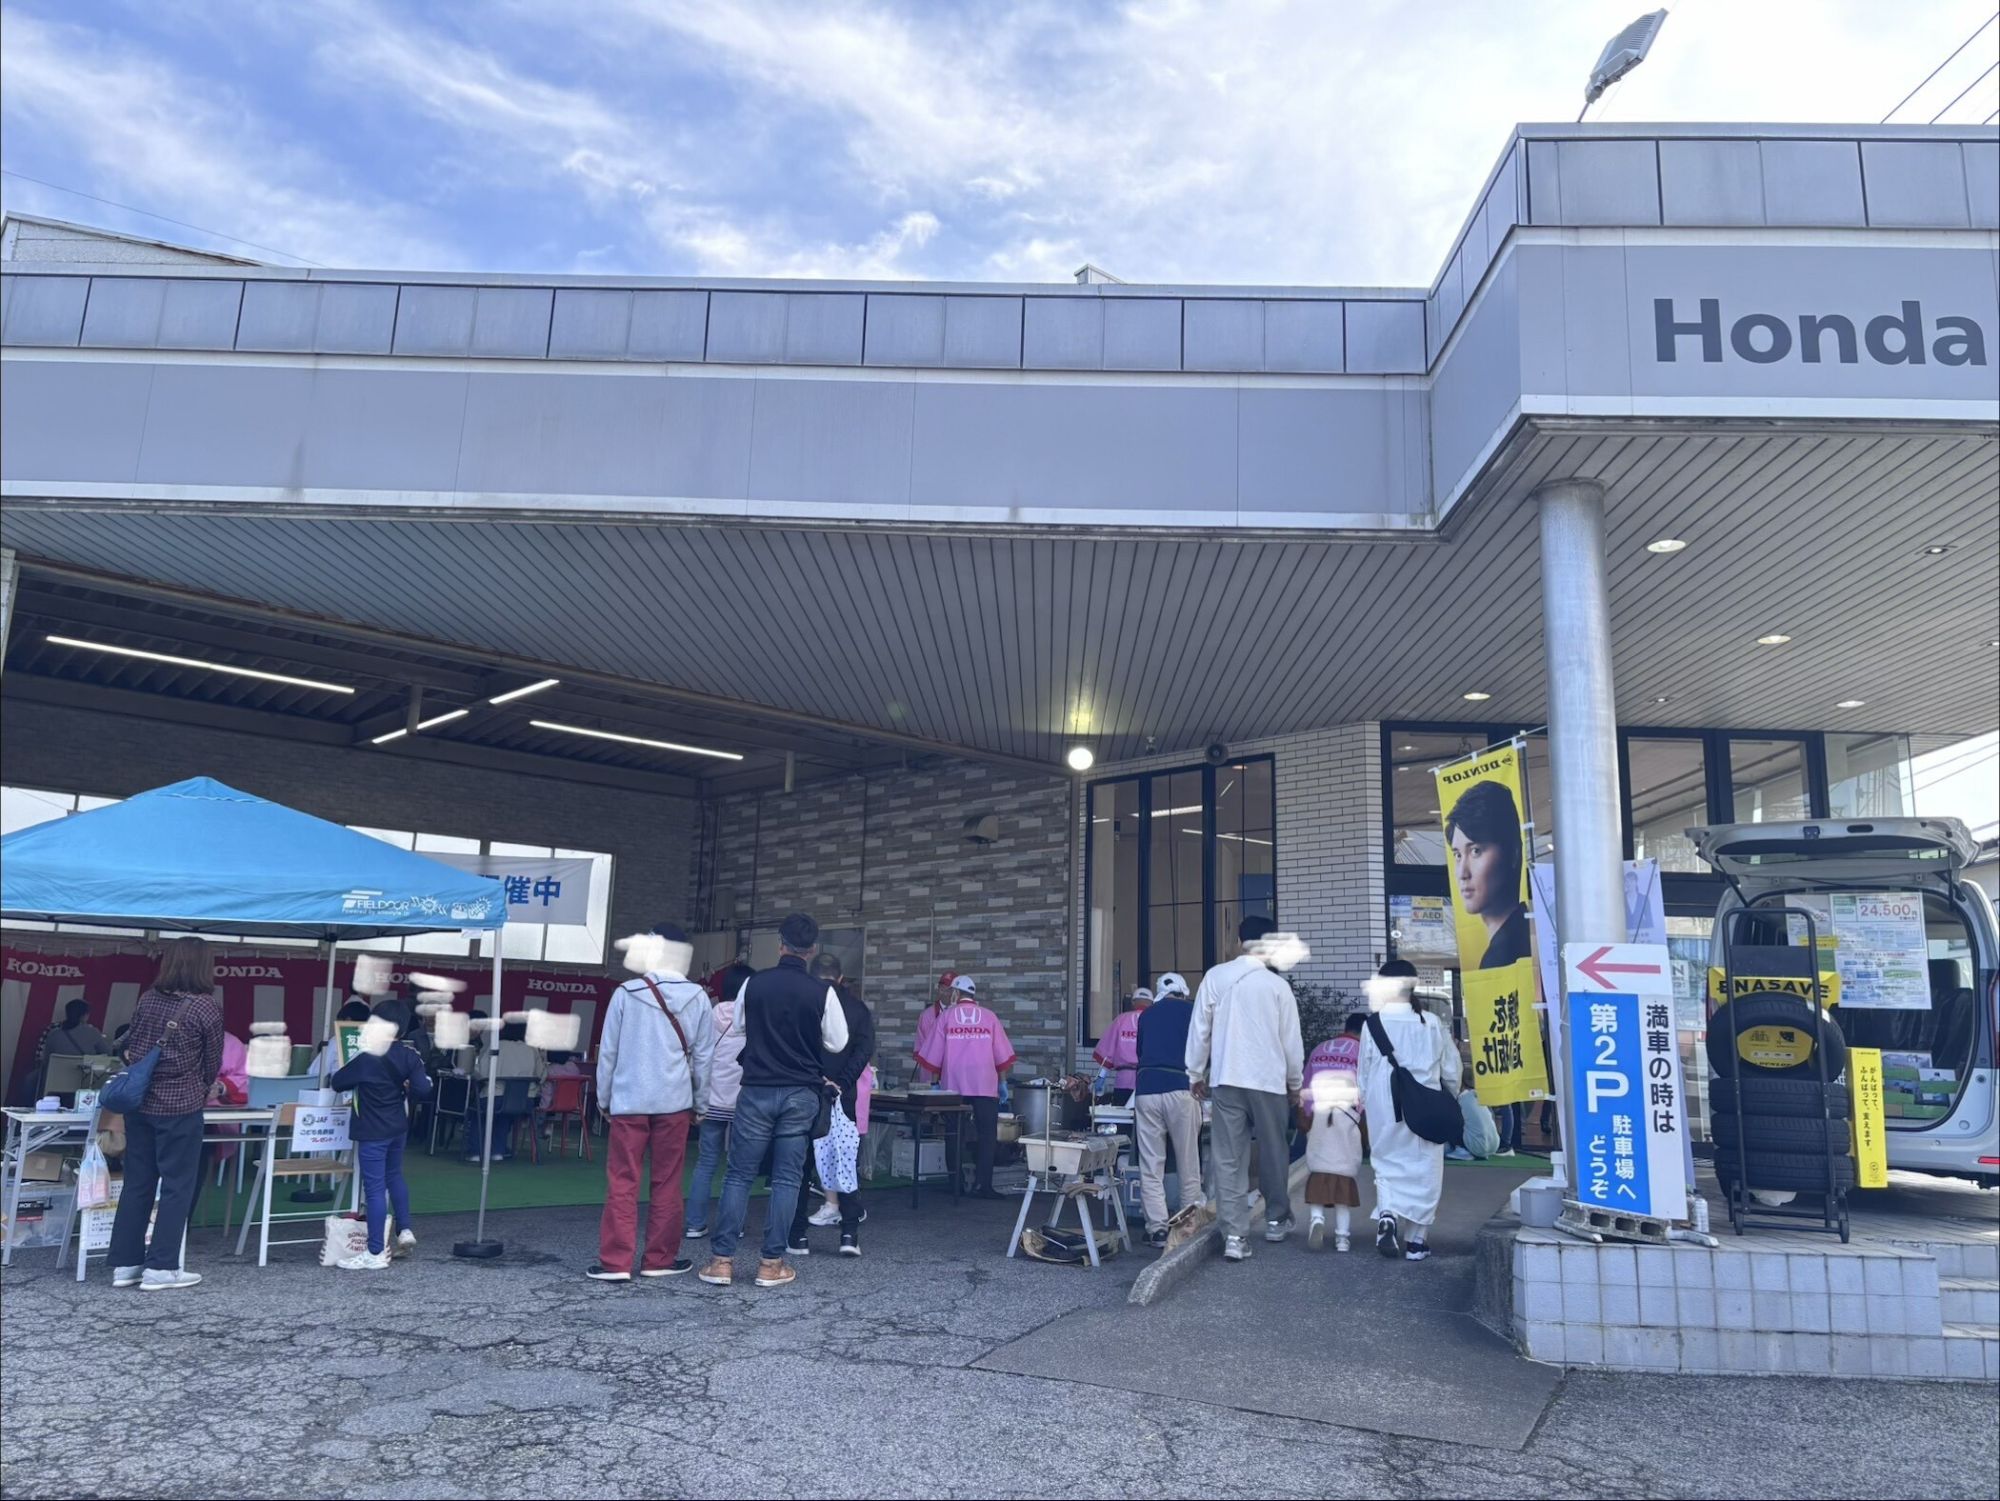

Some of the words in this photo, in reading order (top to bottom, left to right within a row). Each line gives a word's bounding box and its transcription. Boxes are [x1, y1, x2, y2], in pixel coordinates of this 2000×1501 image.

[1654, 298, 1987, 366] Honda
[357, 899, 410, 910] FIELDOOR
[478, 874, 561, 906] 催中
[214, 965, 283, 978] ONDA
[528, 978, 598, 995] HONDA
[1718, 979, 1830, 998] ENASAVE
[1646, 1003, 1675, 1133] 満車の時は
[1588, 1134, 1608, 1200] どうぞ
[1612, 1114, 1637, 1200] 駐車場へ
